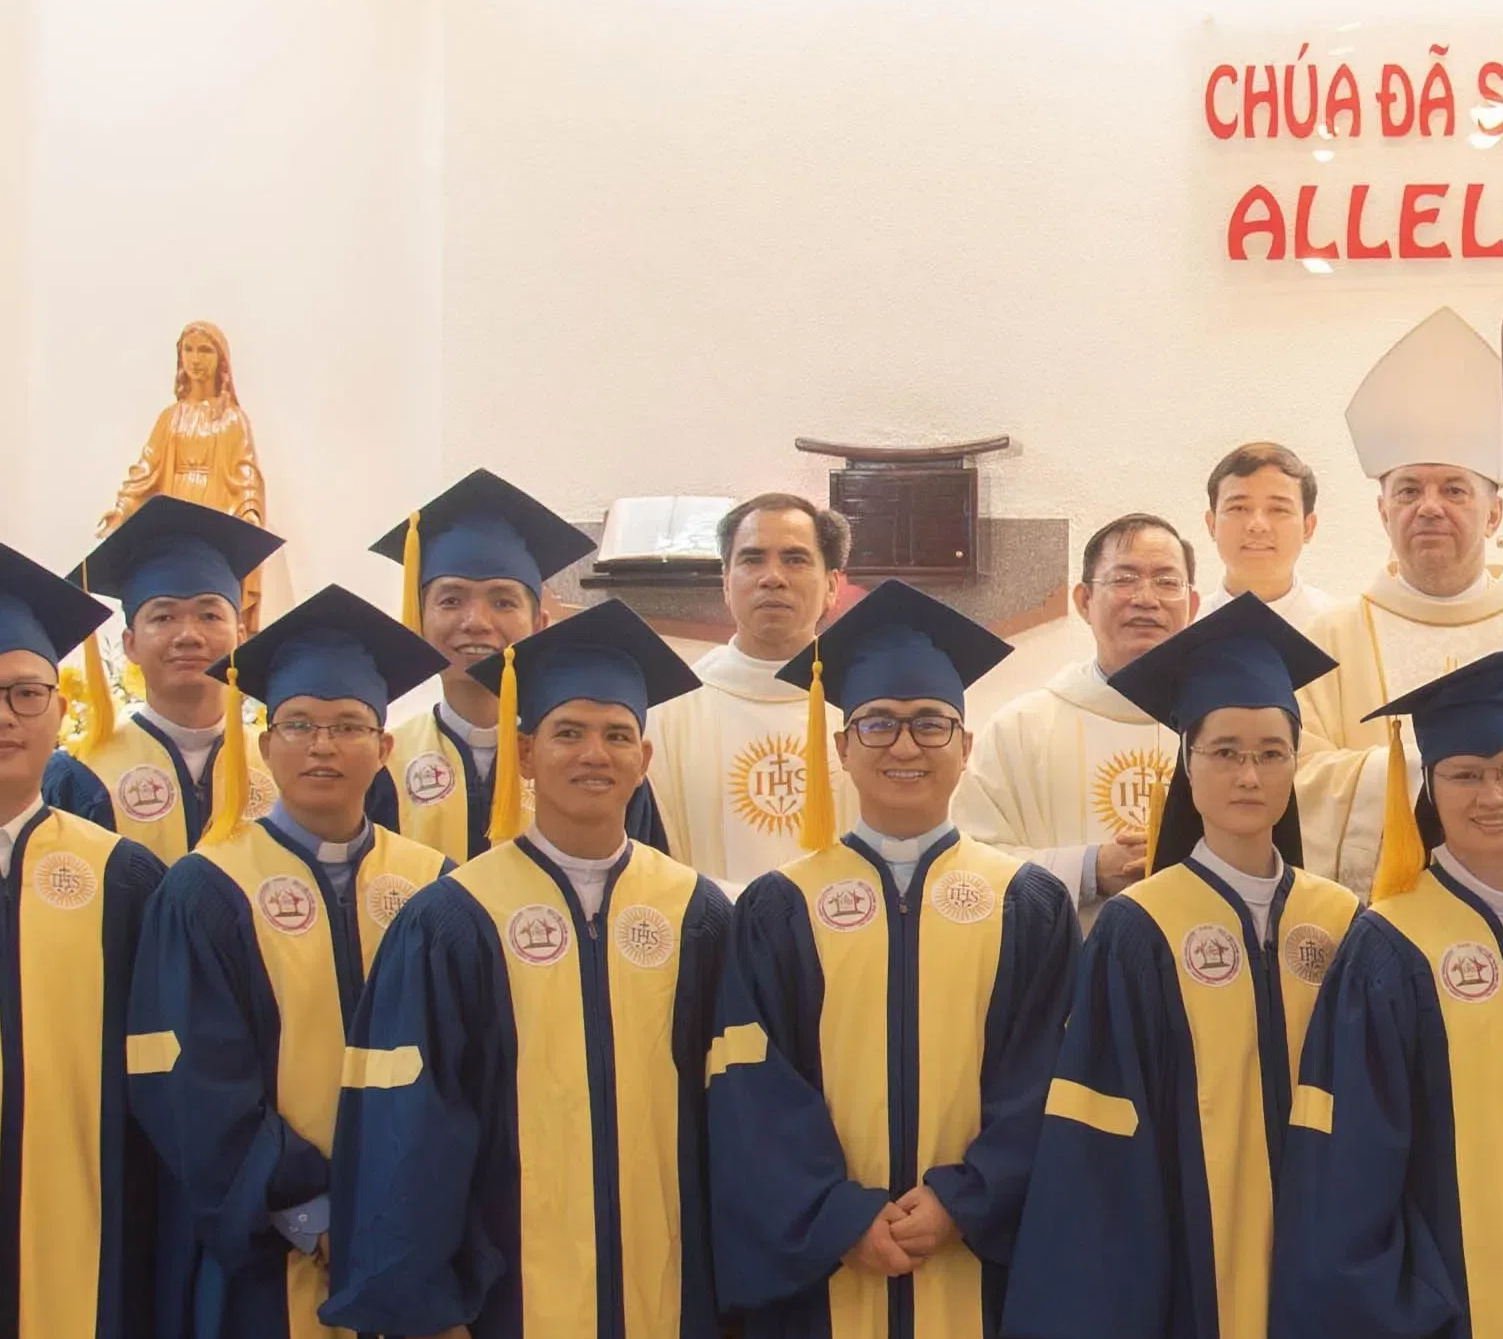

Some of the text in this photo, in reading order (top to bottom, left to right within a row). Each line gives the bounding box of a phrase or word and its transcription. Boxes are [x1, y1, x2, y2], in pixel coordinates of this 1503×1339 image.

[1204, 43, 1362, 141] CHÚA
[1376, 44, 1456, 139] ĐÃ
[51, 872, 81, 888] IHS
[950, 886, 979, 903] IHS
[631, 927, 658, 945] IHS
[1299, 946, 1325, 962] IHS
